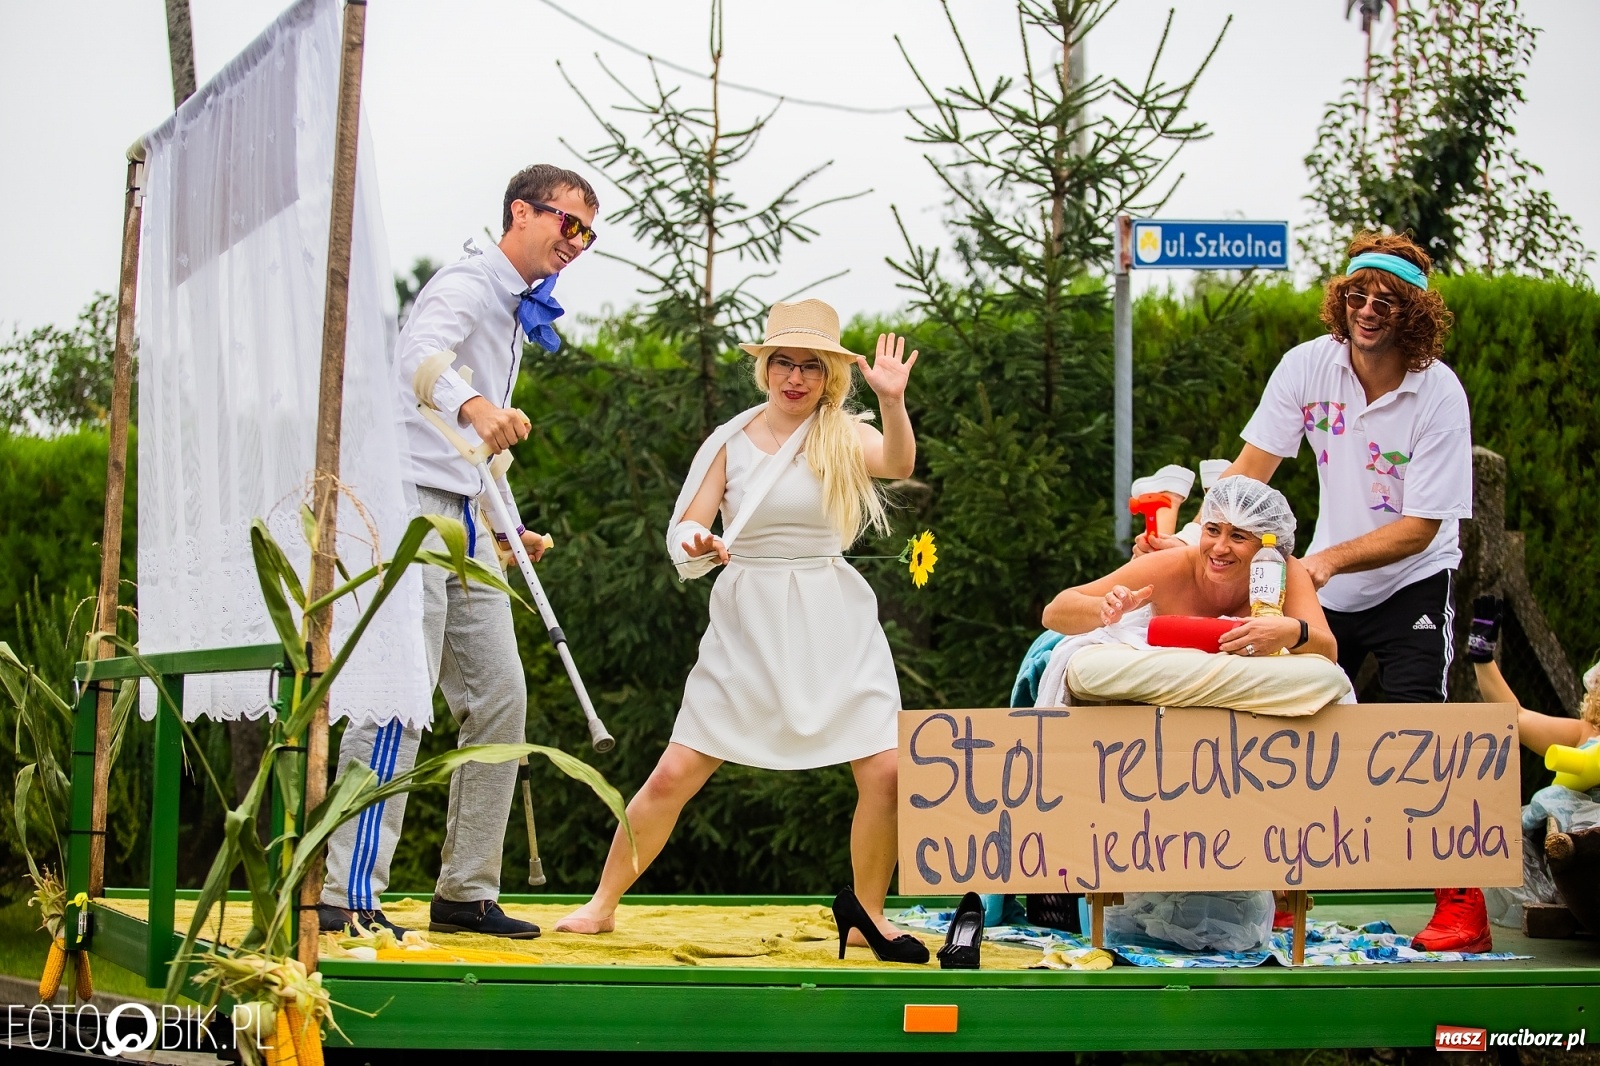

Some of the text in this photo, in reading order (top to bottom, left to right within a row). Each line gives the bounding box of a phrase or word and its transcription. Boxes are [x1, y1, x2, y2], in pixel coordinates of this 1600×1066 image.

[1092, 707, 1340, 804] relaksu
[1366, 724, 1515, 818] czyni
[1263, 805, 1372, 886] cycki
[1406, 816, 1415, 861] i
[1431, 798, 1510, 860] uda
